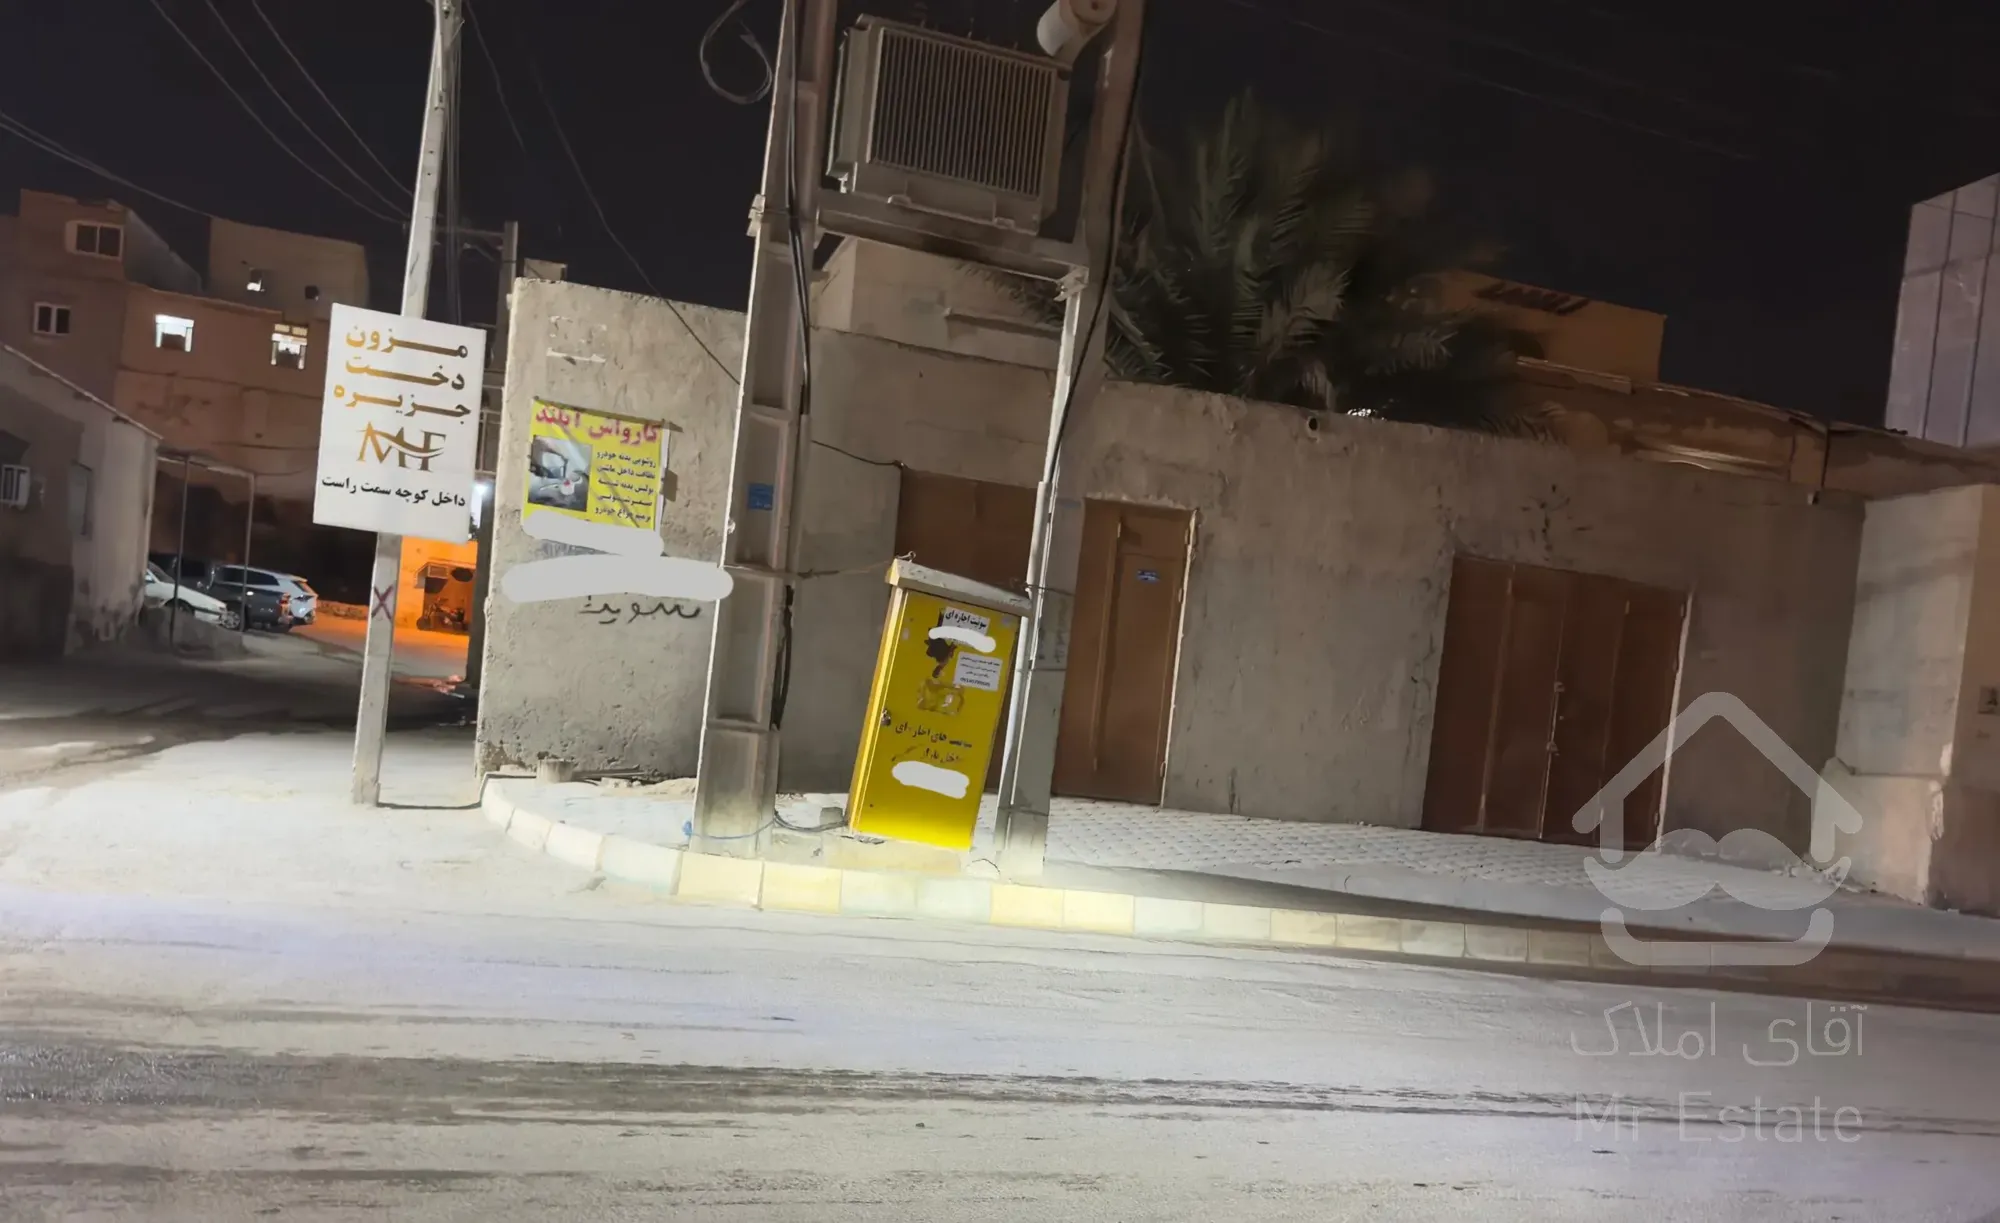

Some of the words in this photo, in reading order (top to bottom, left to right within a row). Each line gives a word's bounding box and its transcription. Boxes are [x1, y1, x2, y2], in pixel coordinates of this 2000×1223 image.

[346, 326, 468, 358] مزون
[345, 356, 465, 390] دخت
[333, 384, 471, 424] جزیره
[322, 476, 356, 493] راست
[361, 481, 391, 495] سمت
[395, 486, 429, 503] کوچه
[432, 492, 466, 507] داخل
